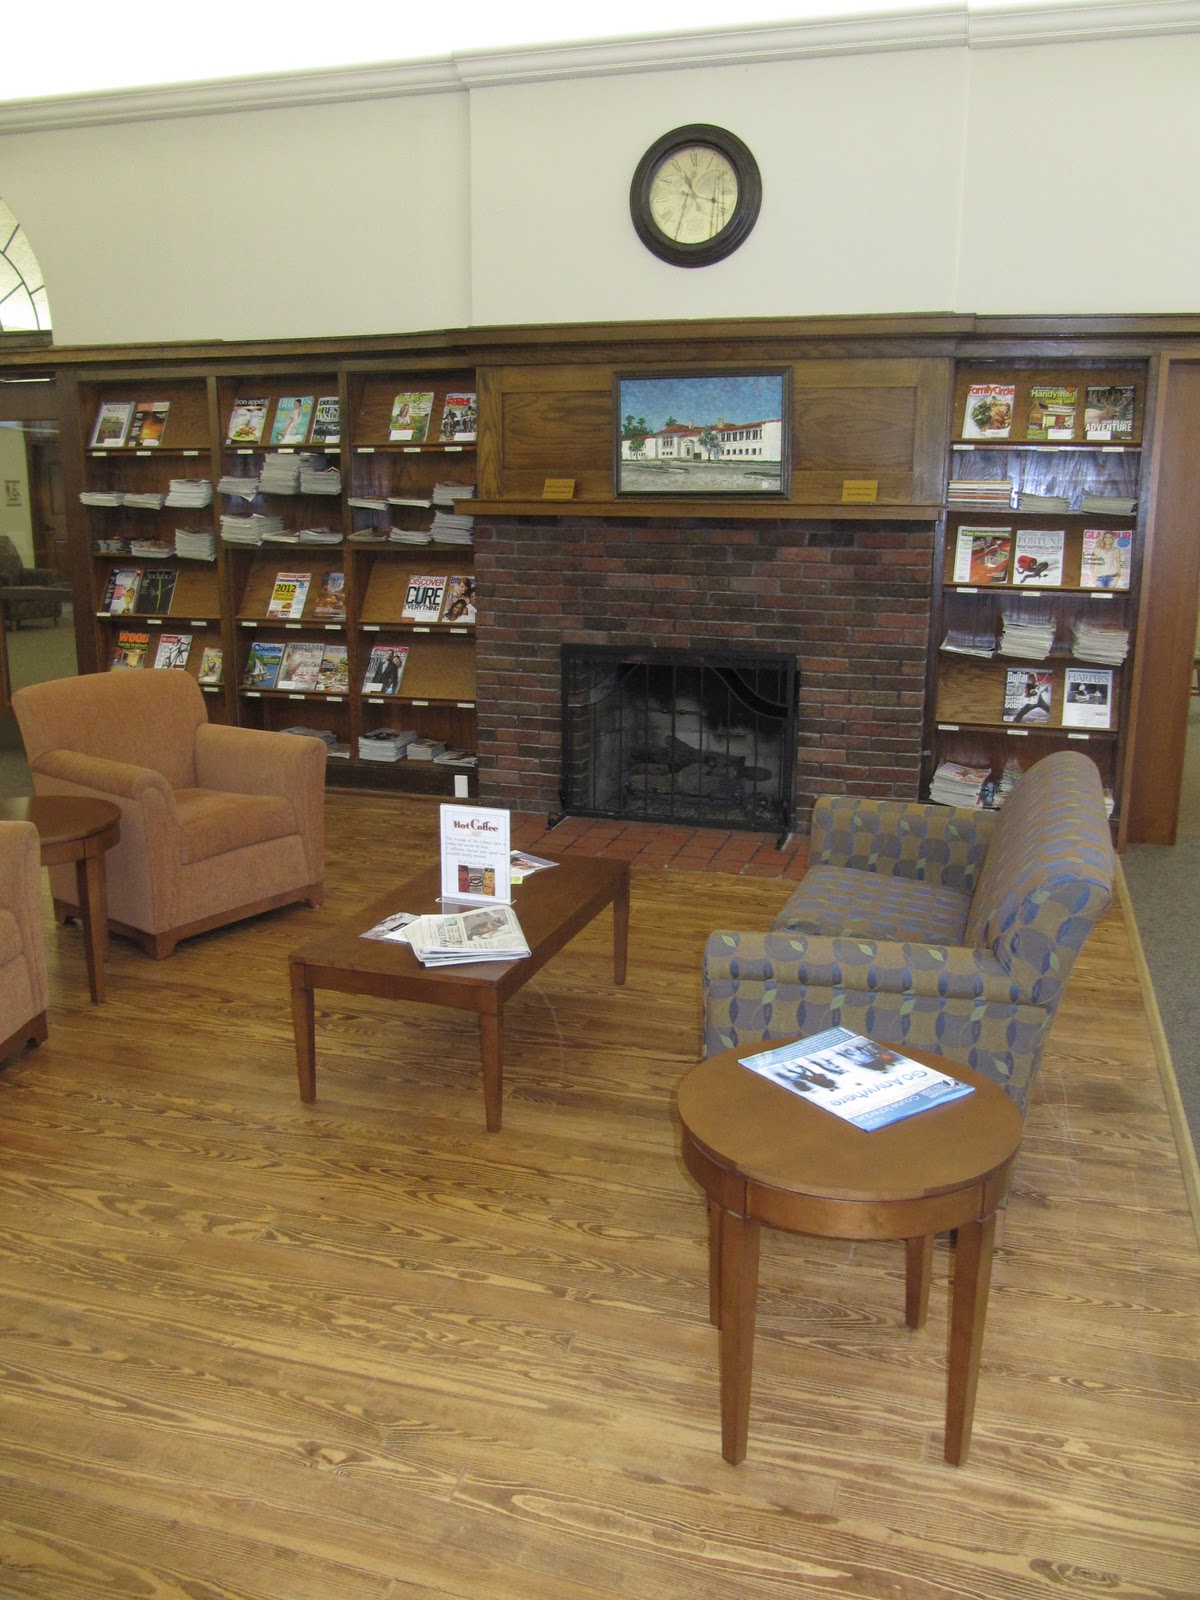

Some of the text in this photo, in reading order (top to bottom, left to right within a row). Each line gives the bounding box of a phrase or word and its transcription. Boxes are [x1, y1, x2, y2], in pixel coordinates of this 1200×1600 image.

[1031, 389, 1077, 399] Handyman
[1085, 423, 1133, 432] ADVENTURE
[1018, 536, 1062, 545] FORTUNE
[409, 578, 444, 586] DISCOVER
[275, 583, 297, 592] 2012
[405, 586, 443, 605] CURE
[403, 603, 440, 611] EVERYTHING
[253, 643, 283, 652] Country
[1007, 671, 1028, 683] Guitar
[453, 818, 499, 832] Hot Coffee
[902, 1070, 928, 1081] Go
